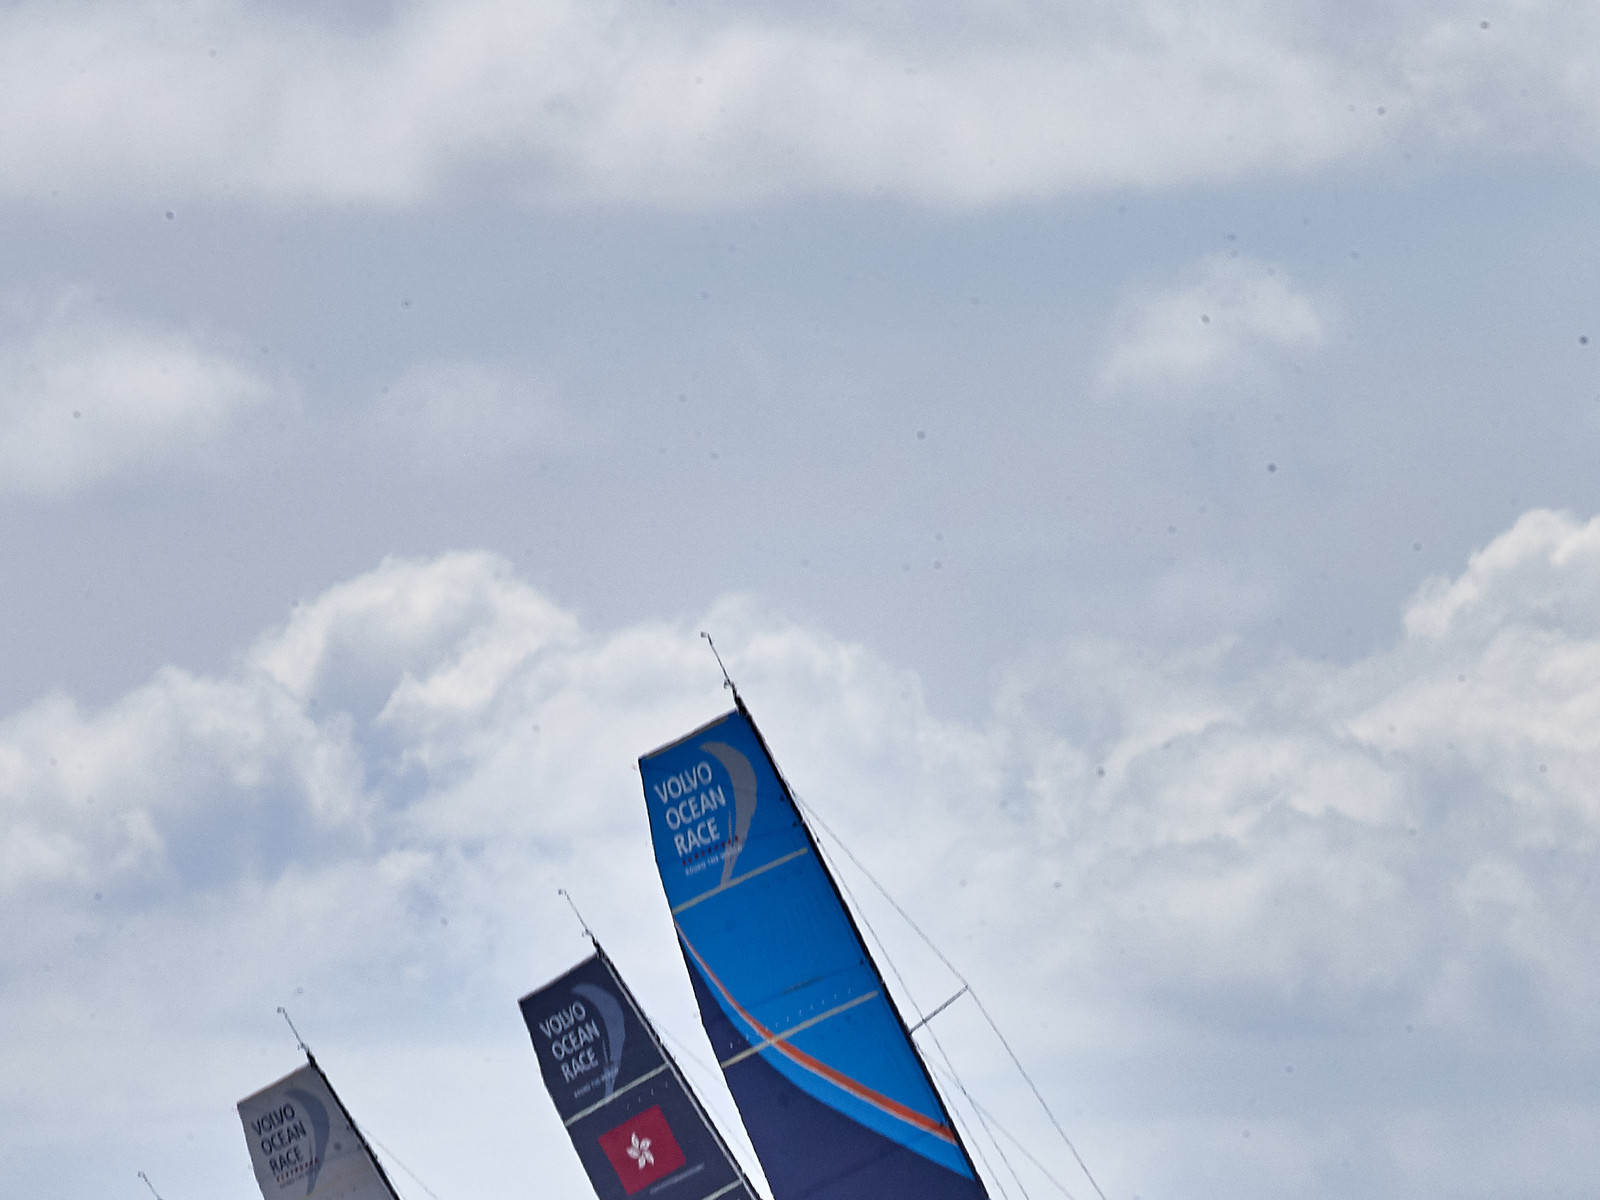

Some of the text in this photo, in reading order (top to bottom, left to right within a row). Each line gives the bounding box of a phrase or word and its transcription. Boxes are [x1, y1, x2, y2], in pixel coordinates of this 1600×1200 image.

[654, 761, 713, 805] VOLVO
[665, 785, 726, 830] OCEAN
[674, 817, 721, 858] RACE
[539, 1001, 587, 1040] VOLVO
[552, 1020, 601, 1061] OCEAN
[561, 1050, 599, 1084] RACE
[251, 1103, 296, 1136] VOLVO
[260, 1120, 307, 1156] OCEAN
[269, 1147, 304, 1175] RACE
